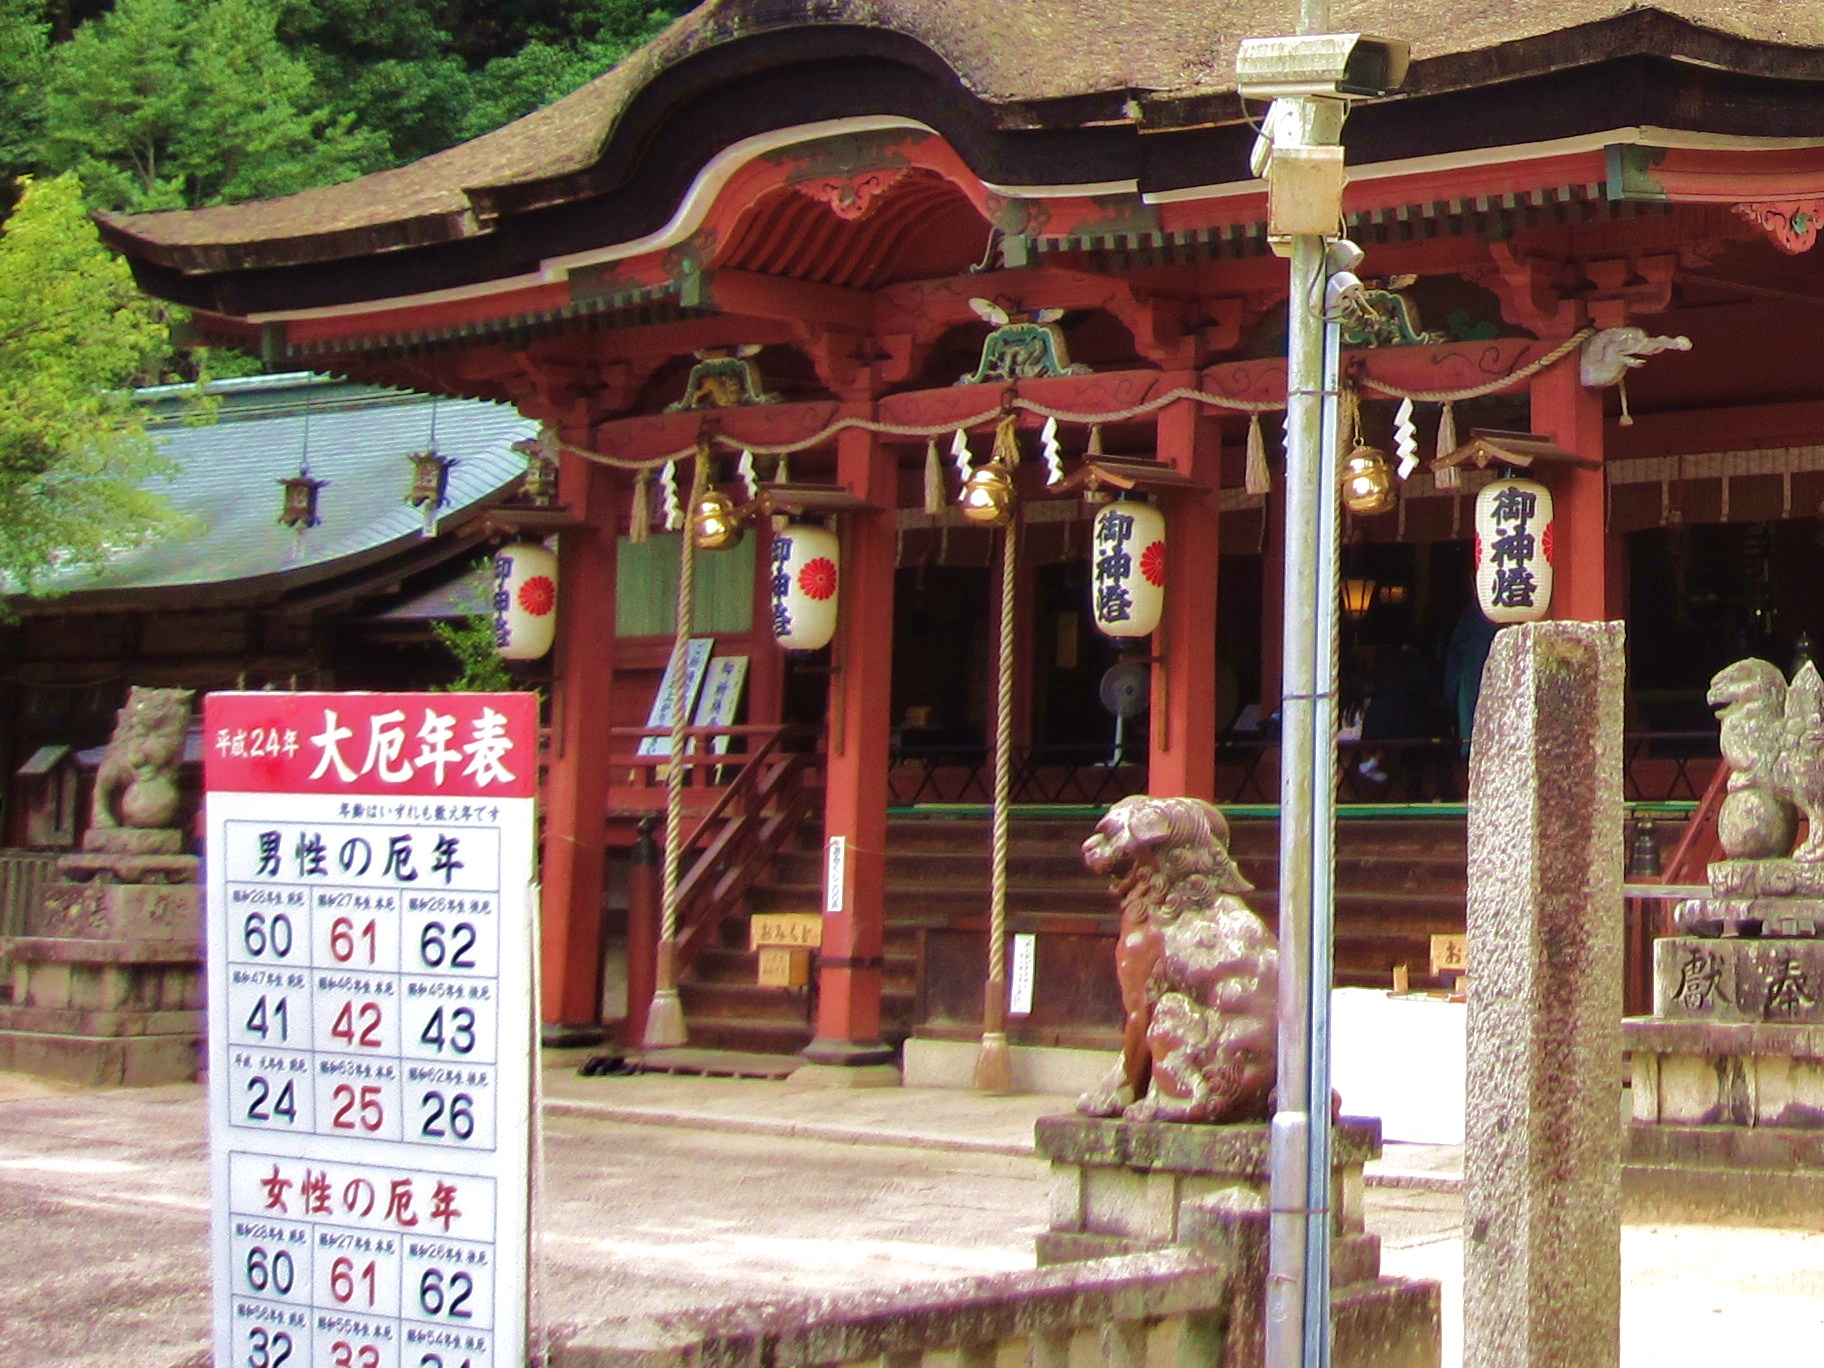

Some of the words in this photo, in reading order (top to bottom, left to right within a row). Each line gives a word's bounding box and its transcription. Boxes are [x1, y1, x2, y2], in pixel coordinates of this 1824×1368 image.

[1096, 509, 1134, 624] 御神燈
[1489, 485, 1538, 608] 御神燈
[215, 728, 300, 759] 平成24年
[308, 706, 517, 788] 大厄年表
[256, 831, 465, 886] 男性の厄年
[244, 912, 294, 960] 60
[331, 917, 377, 965] 61
[420, 921, 478, 970] 62
[245, 995, 289, 1044] 41
[331, 1001, 383, 1048] 42
[420, 1006, 477, 1055] 43
[247, 1076, 298, 1125] 24
[332, 1084, 385, 1132] 25
[421, 1091, 476, 1142] 26
[260, 1163, 462, 1232] 女性の厄年
[247, 1246, 297, 1296] 60
[331, 1257, 377, 1307] 61
[420, 1268, 475, 1321] 62
[249, 1326, 297, 1368] 32
